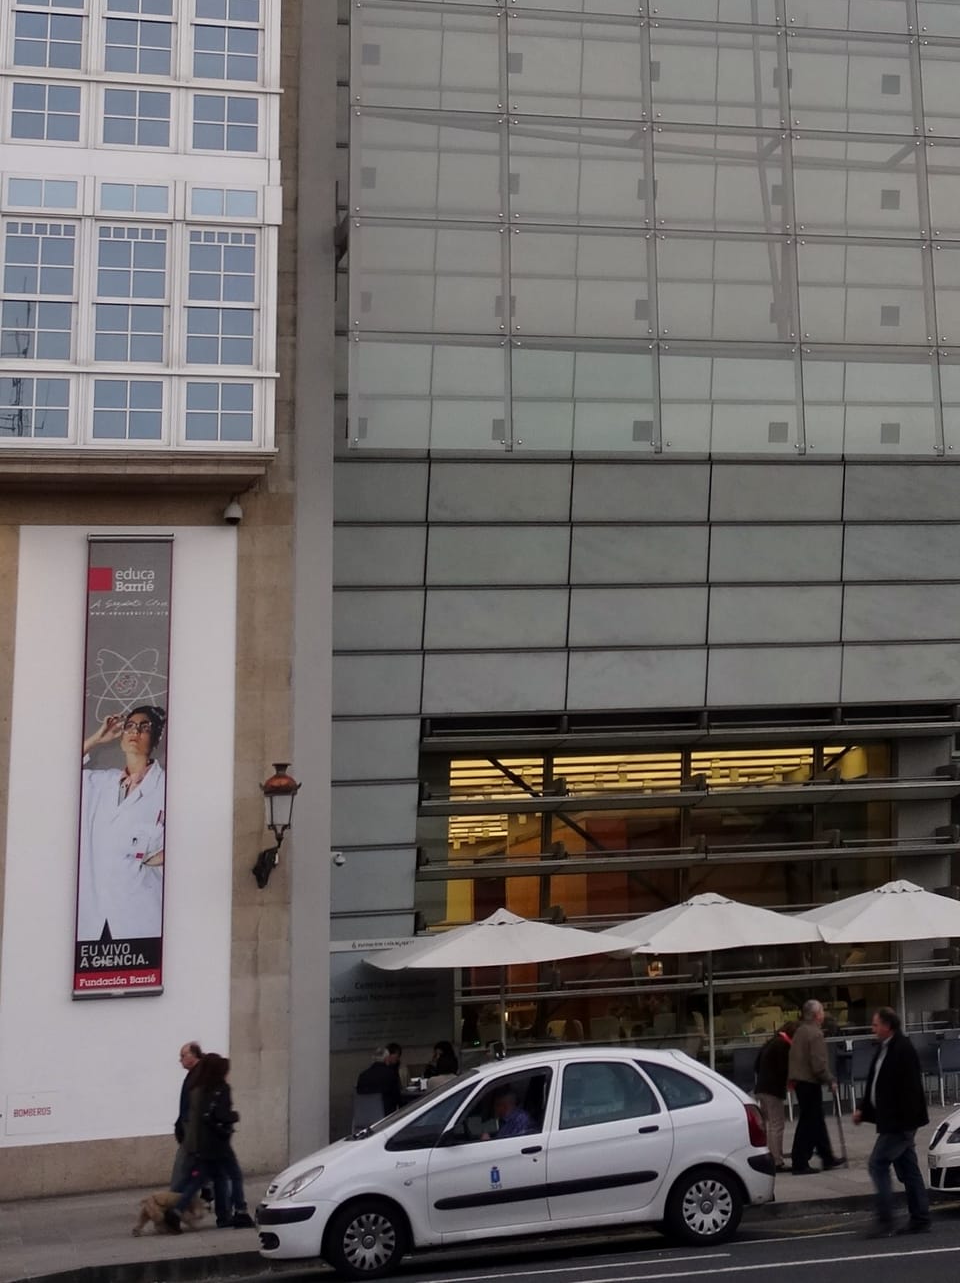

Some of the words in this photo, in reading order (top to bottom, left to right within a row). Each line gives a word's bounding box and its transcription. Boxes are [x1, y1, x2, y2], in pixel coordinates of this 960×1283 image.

[115, 567, 155, 580] educa
[115, 580, 154, 592] Barrié
[81, 944, 98, 957] EU
[102, 943, 131, 955] VIVO
[80, 957, 89, 968] A
[79, 976, 127, 987] Fundación
